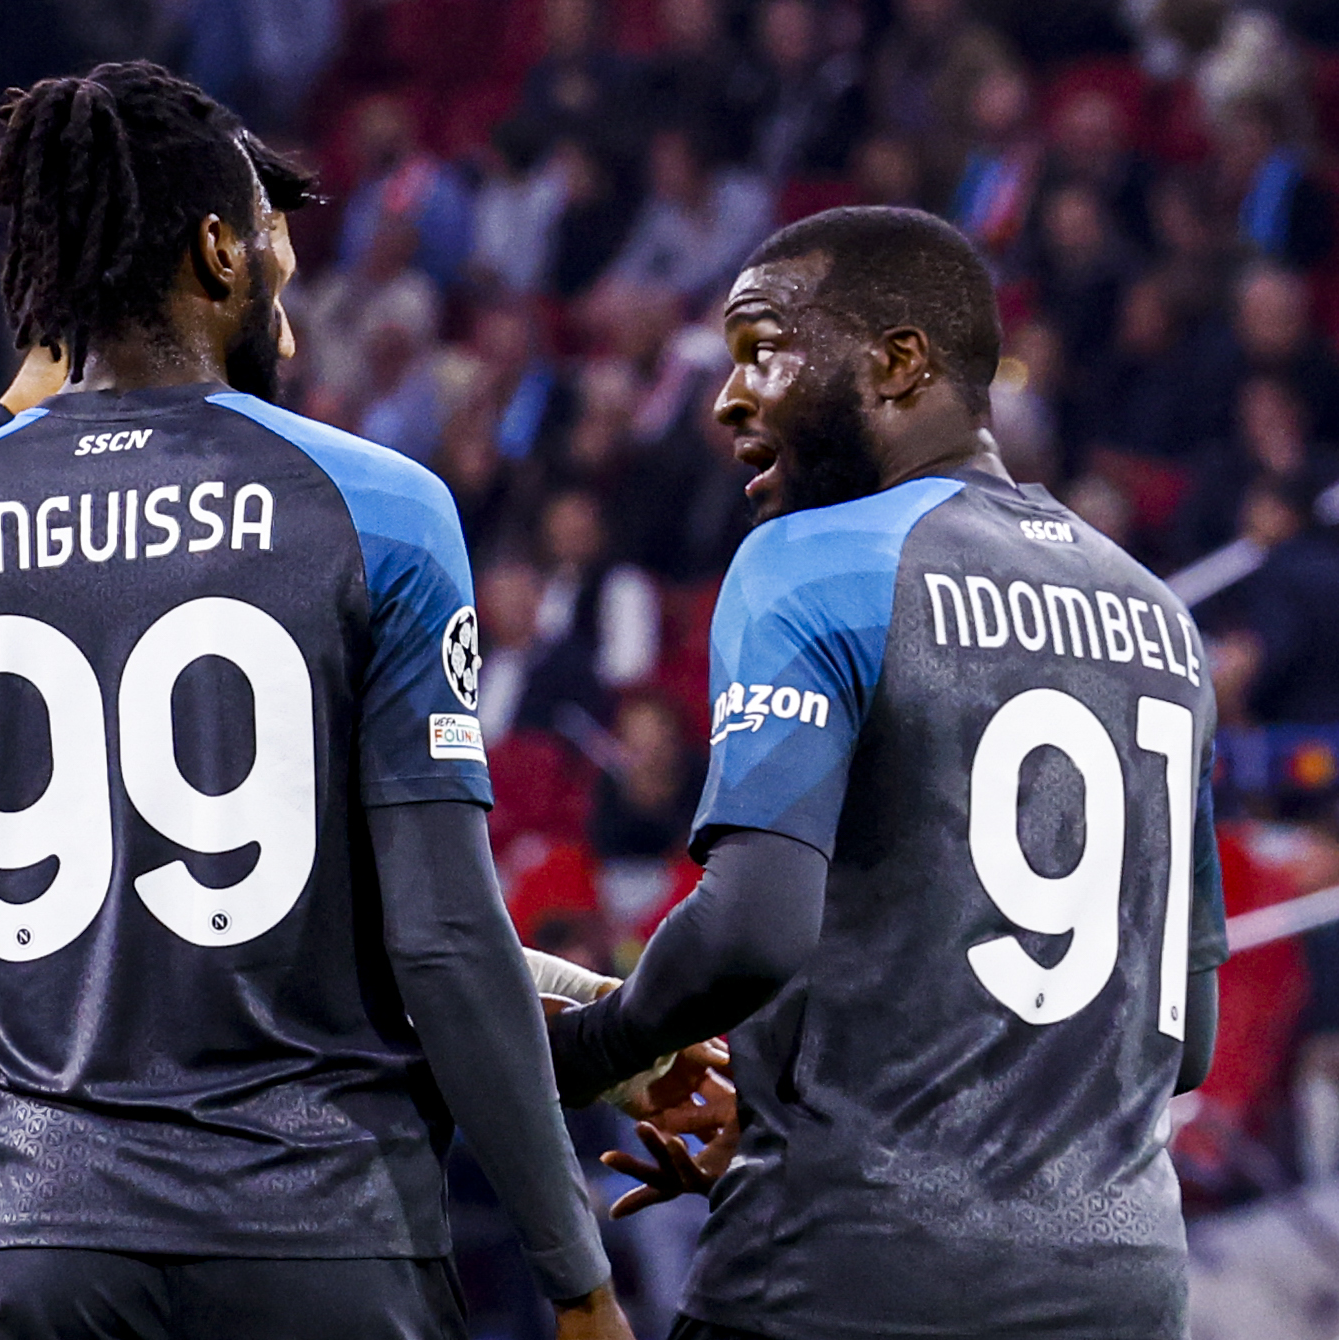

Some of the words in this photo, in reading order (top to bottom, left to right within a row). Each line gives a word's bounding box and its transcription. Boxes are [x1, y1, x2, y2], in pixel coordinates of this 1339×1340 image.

[75, 428, 153, 456] SSCN
[1020, 520, 1073, 542] SSCN
[923, 572, 1201, 687] NDOMBELE
[966, 687, 1194, 1042] 91
